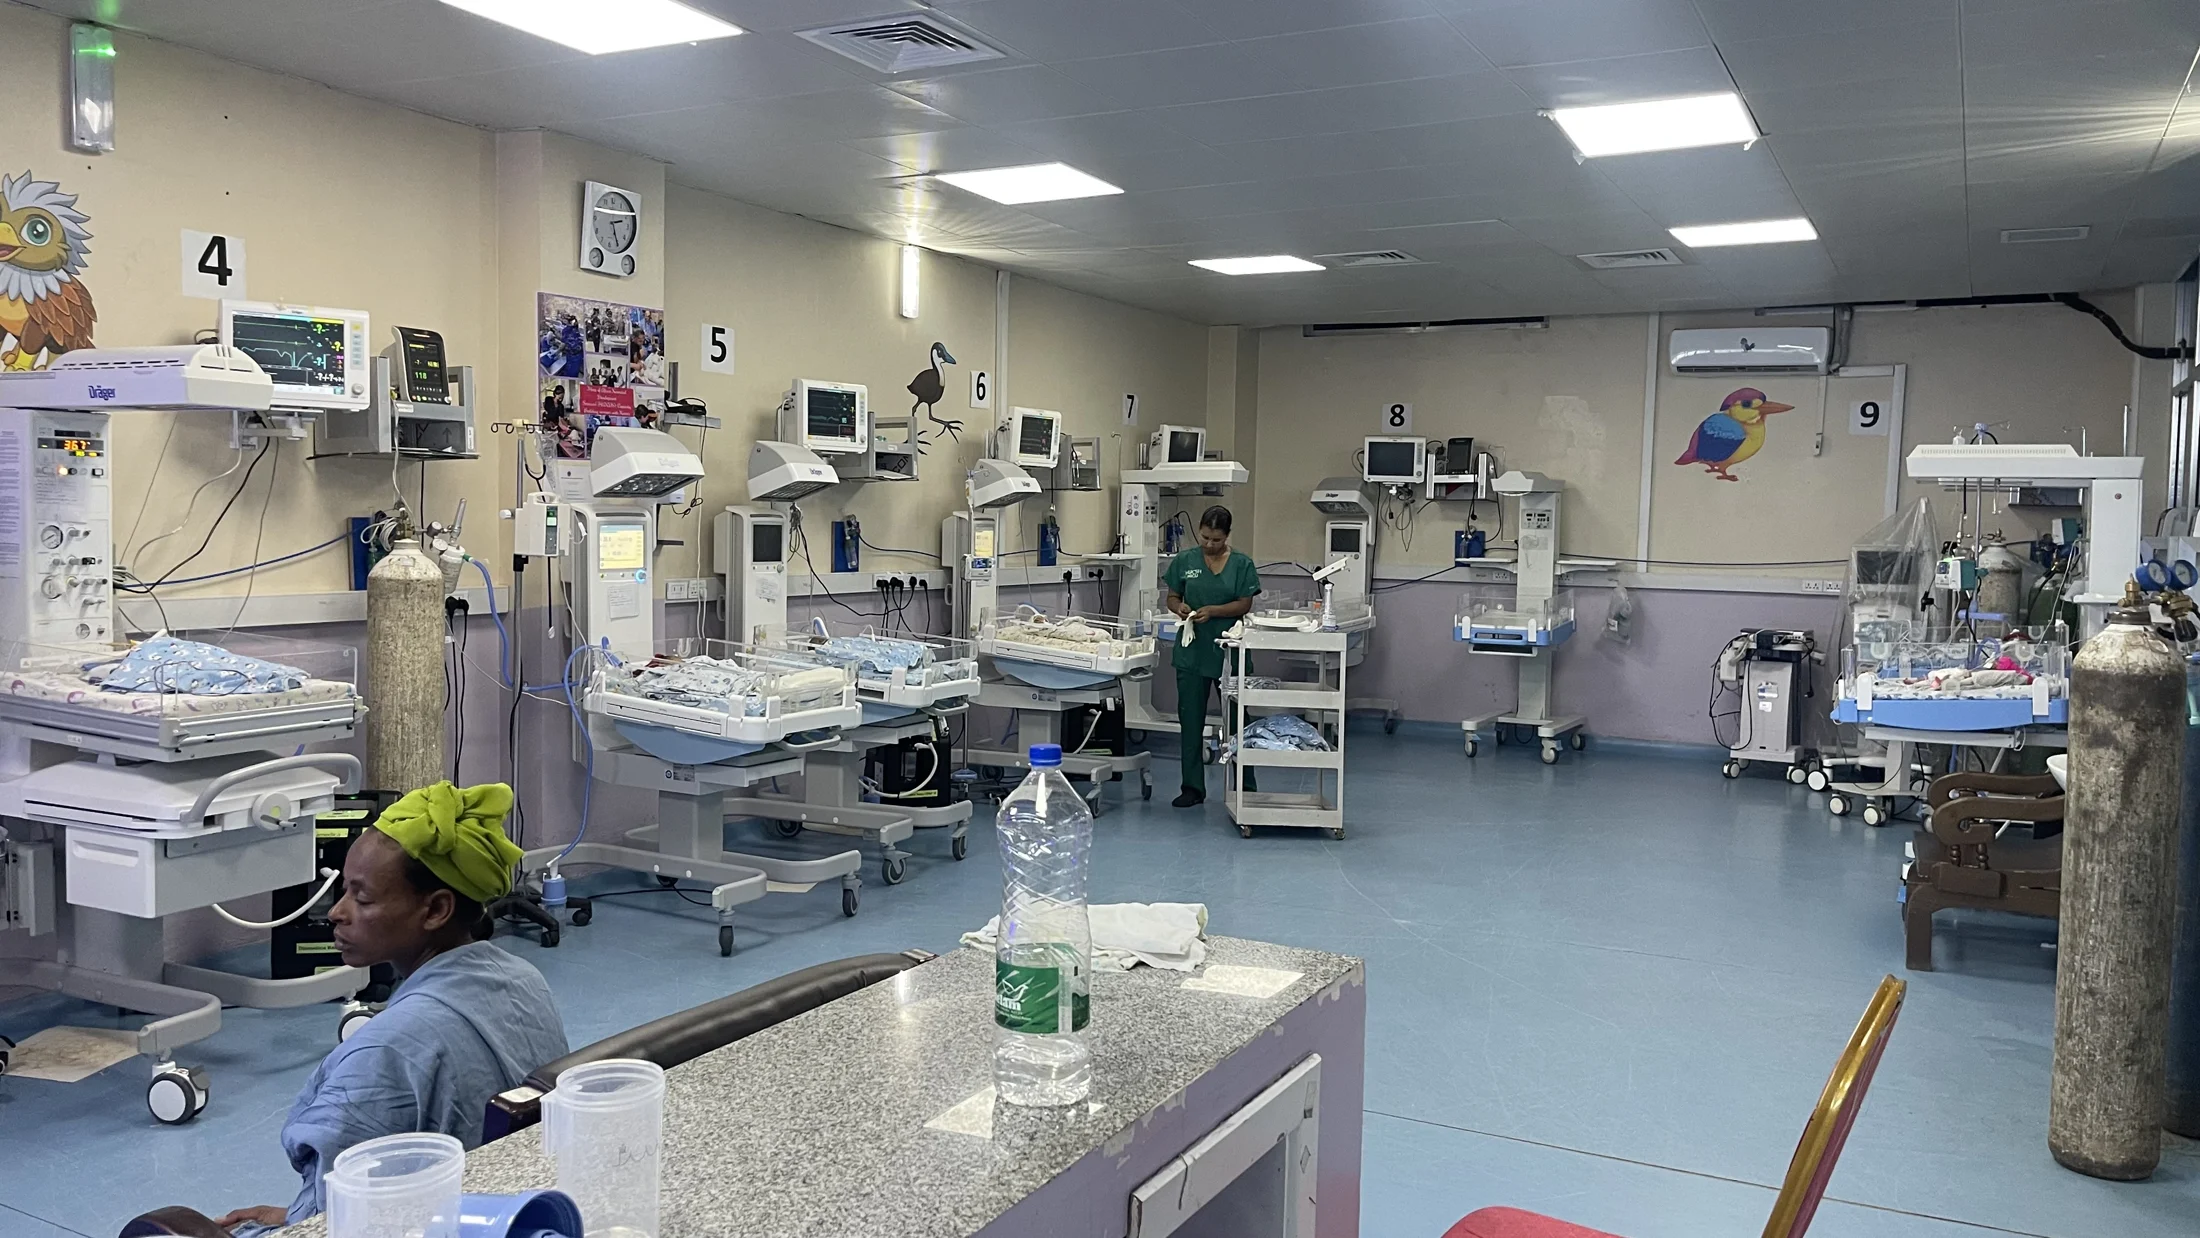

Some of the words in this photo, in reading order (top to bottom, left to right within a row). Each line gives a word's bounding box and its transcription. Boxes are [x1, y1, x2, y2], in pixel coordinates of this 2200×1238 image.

[198, 236, 232, 286] 4
[710, 327, 727, 363] 5
[88, 385, 116, 401] Dräger
[976, 371, 986, 401] 6
[1126, 394, 1136, 419] 7
[1389, 404, 1405, 428] 8
[1860, 402, 1880, 428] 9
